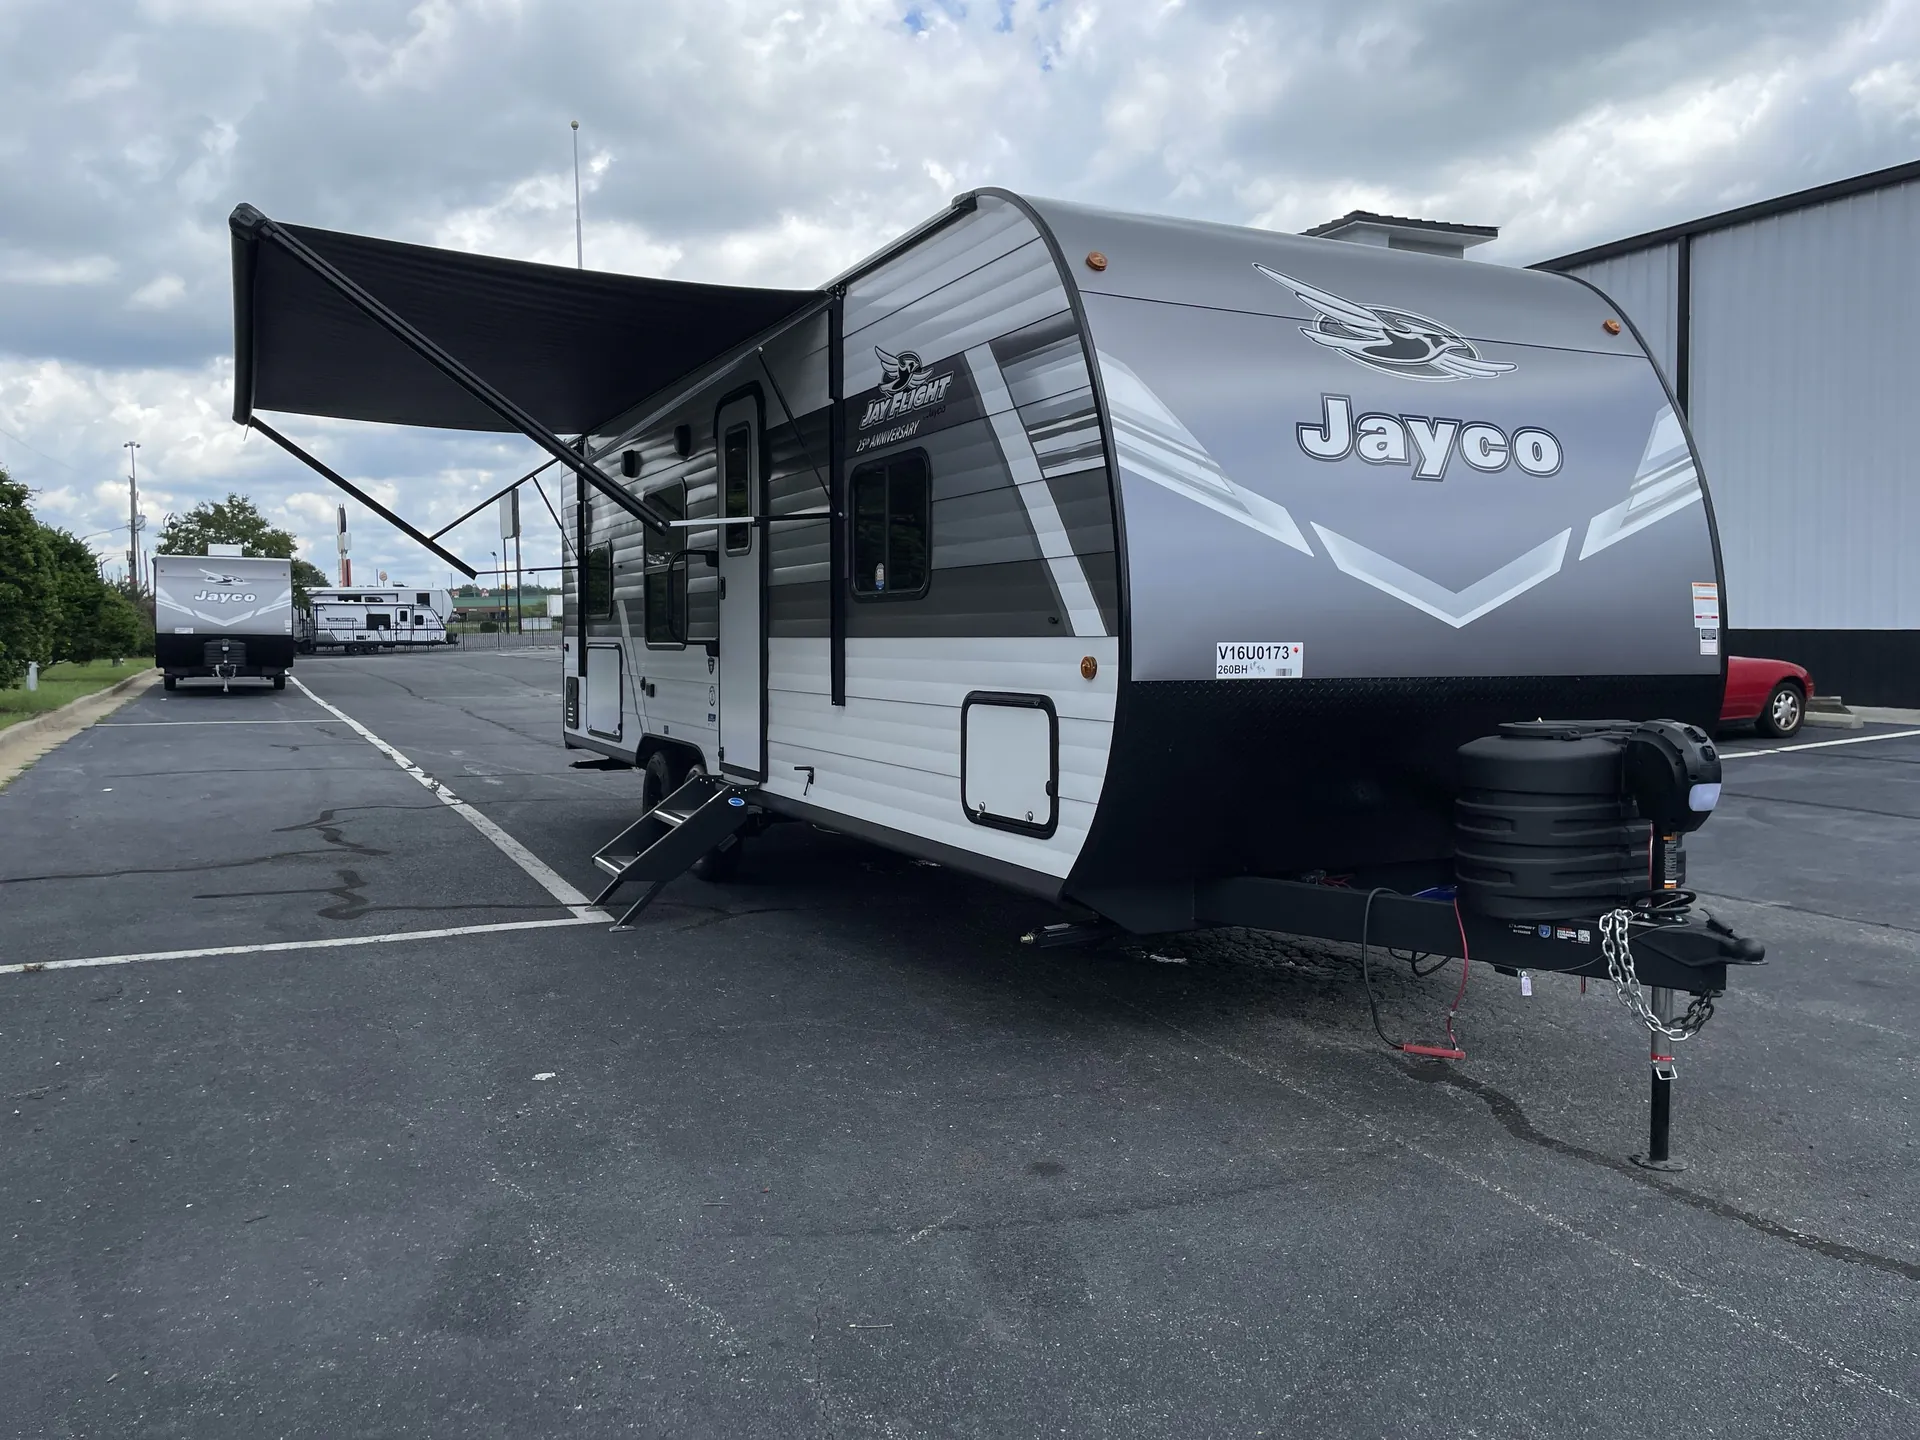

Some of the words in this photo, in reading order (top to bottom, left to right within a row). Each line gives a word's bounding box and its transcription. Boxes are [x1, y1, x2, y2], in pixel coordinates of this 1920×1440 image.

[861, 399, 891, 428] JAY
[889, 375, 952, 416] FLIGHT
[869, 420, 920, 448] ANNIVERSARY
[1296, 392, 1563, 482] Jayco
[194, 590, 256, 604] Jayco
[1218, 645, 1290, 660] V16U0173
[1217, 664, 1248, 675] 260BH
